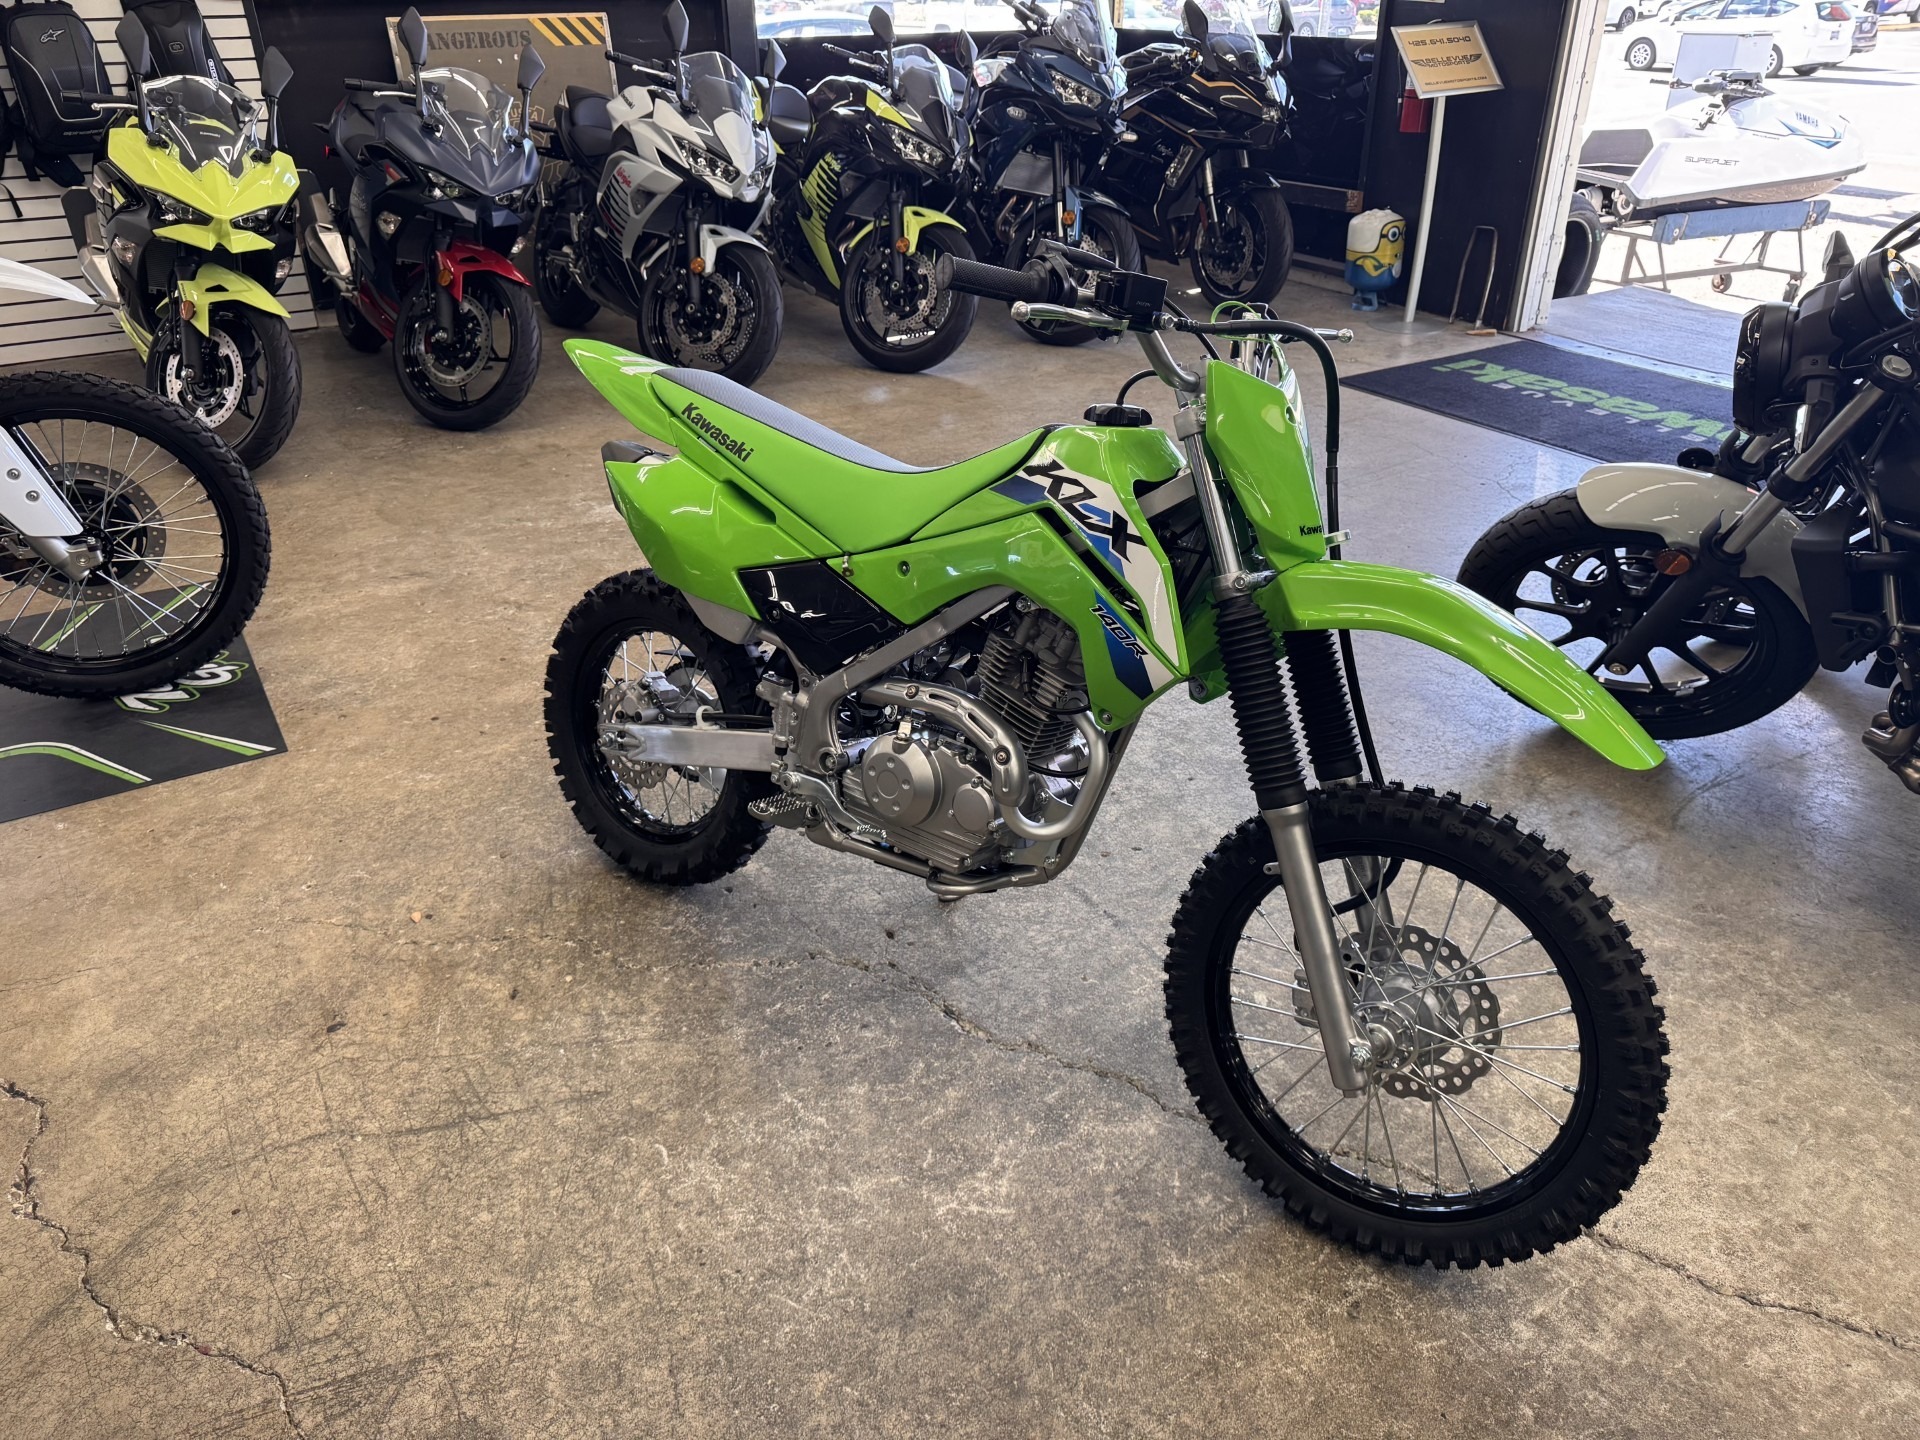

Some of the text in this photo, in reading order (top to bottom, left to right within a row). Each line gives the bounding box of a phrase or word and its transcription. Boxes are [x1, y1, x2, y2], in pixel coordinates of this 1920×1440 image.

[426, 29, 532, 51] ANGEROUS
[1408, 35, 1472, 47] 425.641.5040
[1425, 54, 1469, 64] BELLEVUE
[1794, 111, 1819, 128] YAMAHA
[1684, 155, 1740, 166] SUPERJET
[616, 166, 632, 188] Ninja
[1431, 358, 1746, 442] wasaki
[1491, 382, 1707, 442] ELLEVUE
[680, 402, 754, 463] Kawasaki
[1022, 459, 1150, 564] KLX
[1088, 603, 1149, 659] 140R
